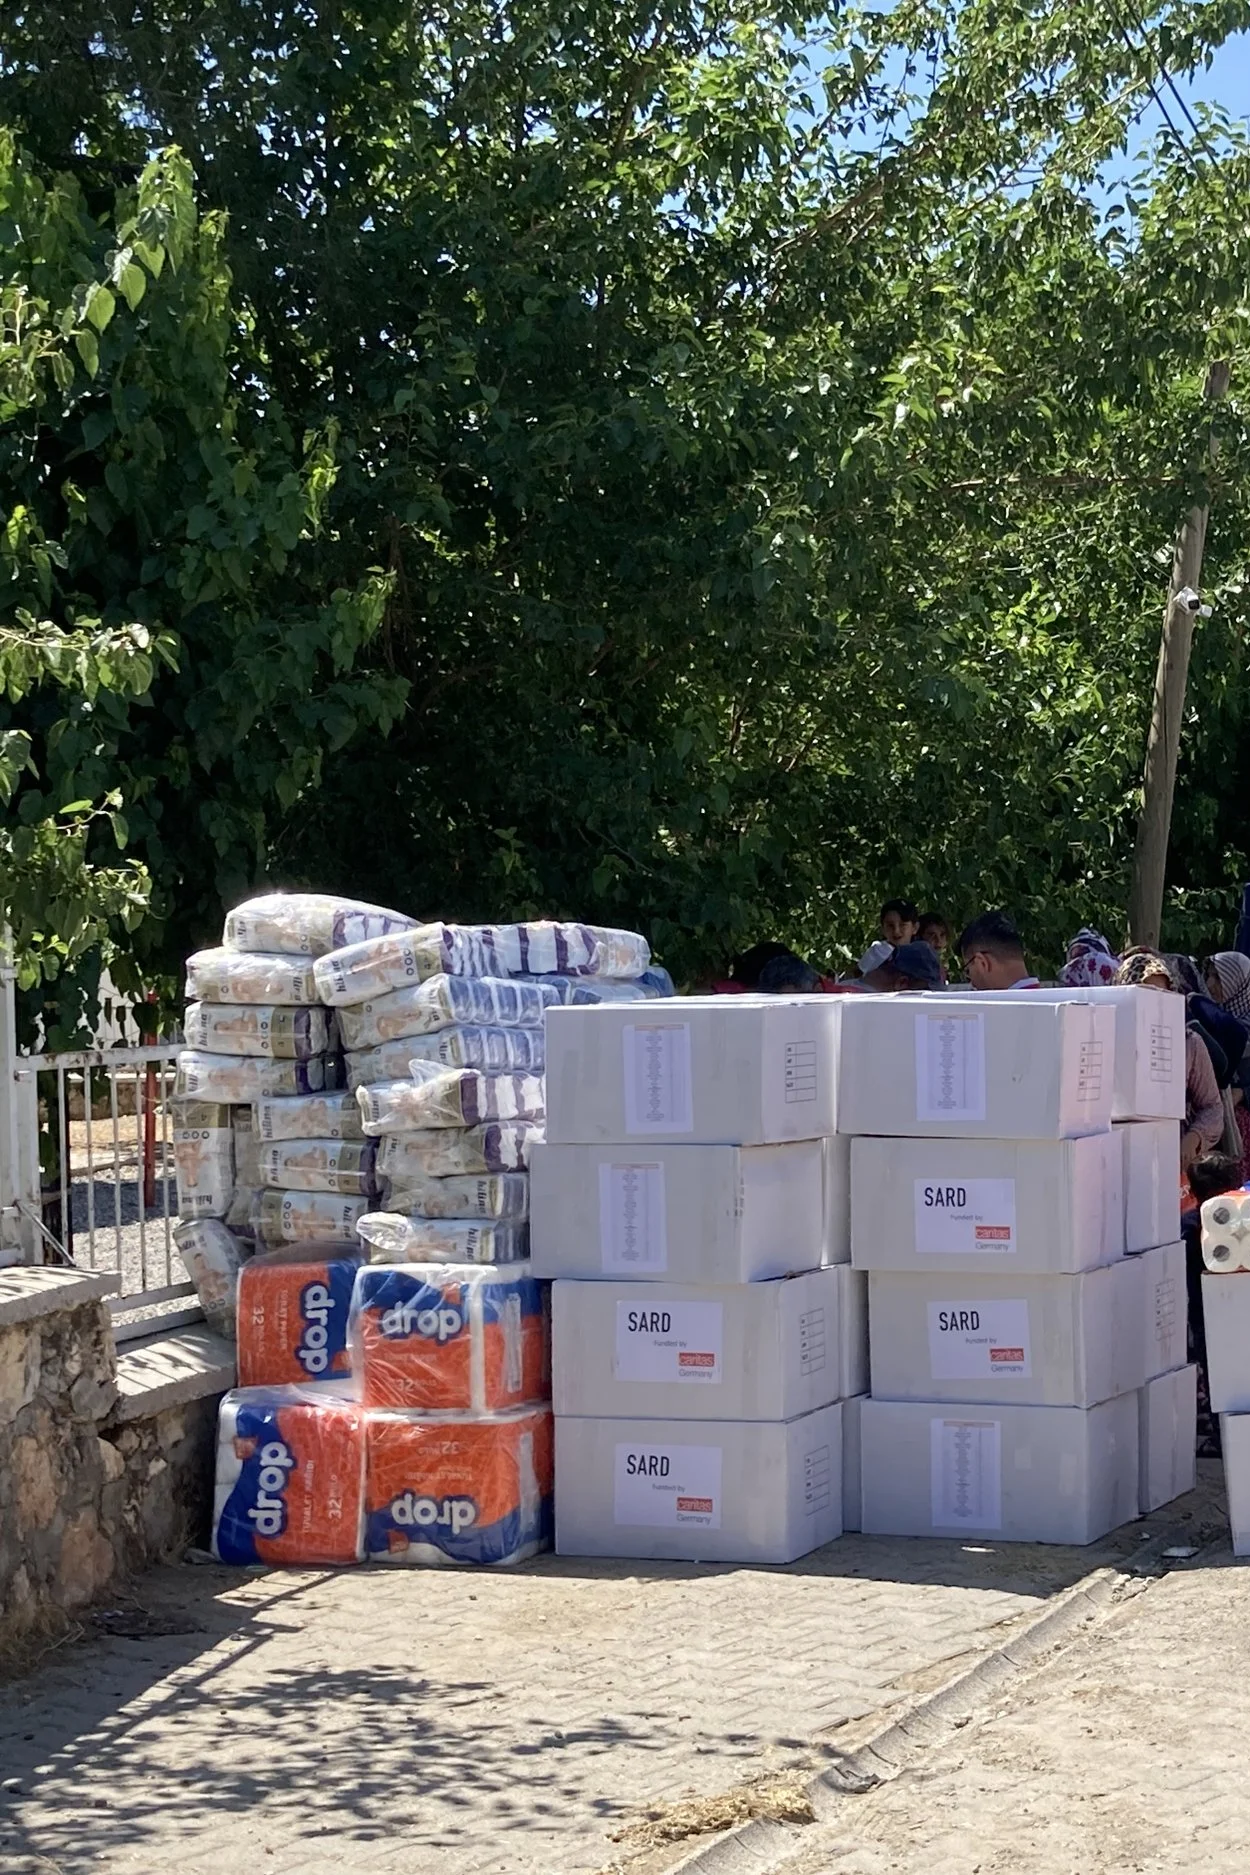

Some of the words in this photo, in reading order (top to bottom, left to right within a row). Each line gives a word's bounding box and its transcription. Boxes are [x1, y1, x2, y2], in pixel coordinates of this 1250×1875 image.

[924, 1187, 966, 1207] SARD
[975, 1241, 1009, 1252] Germany
[252, 1306, 265, 1325] 32
[382, 1301, 461, 1341] drop
[628, 1312, 671, 1332] SARD
[939, 1311, 980, 1331] SARD
[299, 1285, 336, 1373] drop
[679, 1368, 713, 1379] Germany
[991, 1364, 1024, 1373] Germany
[441, 1441, 460, 1454] 32
[627, 1454, 670, 1476] SARD
[248, 1442, 294, 1535] drop
[327, 1497, 343, 1520] 32
[391, 1493, 476, 1535] drop
[676, 1513, 712, 1525] Germany
